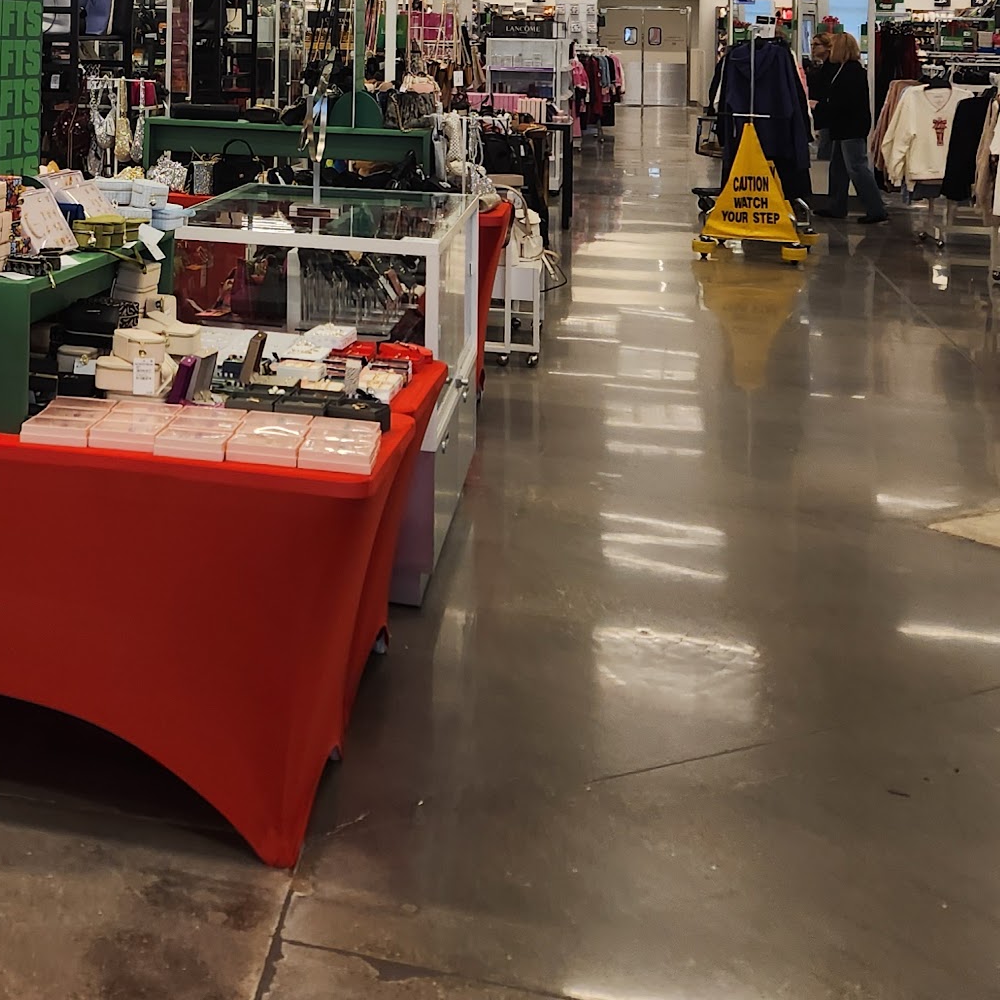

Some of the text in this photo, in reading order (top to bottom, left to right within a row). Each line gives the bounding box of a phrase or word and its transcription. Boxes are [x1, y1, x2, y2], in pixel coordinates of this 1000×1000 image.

[733, 175, 769, 192] CAUTION
[734, 197, 768, 208] WATCH
[721, 211, 780, 224] YOUR STEP
